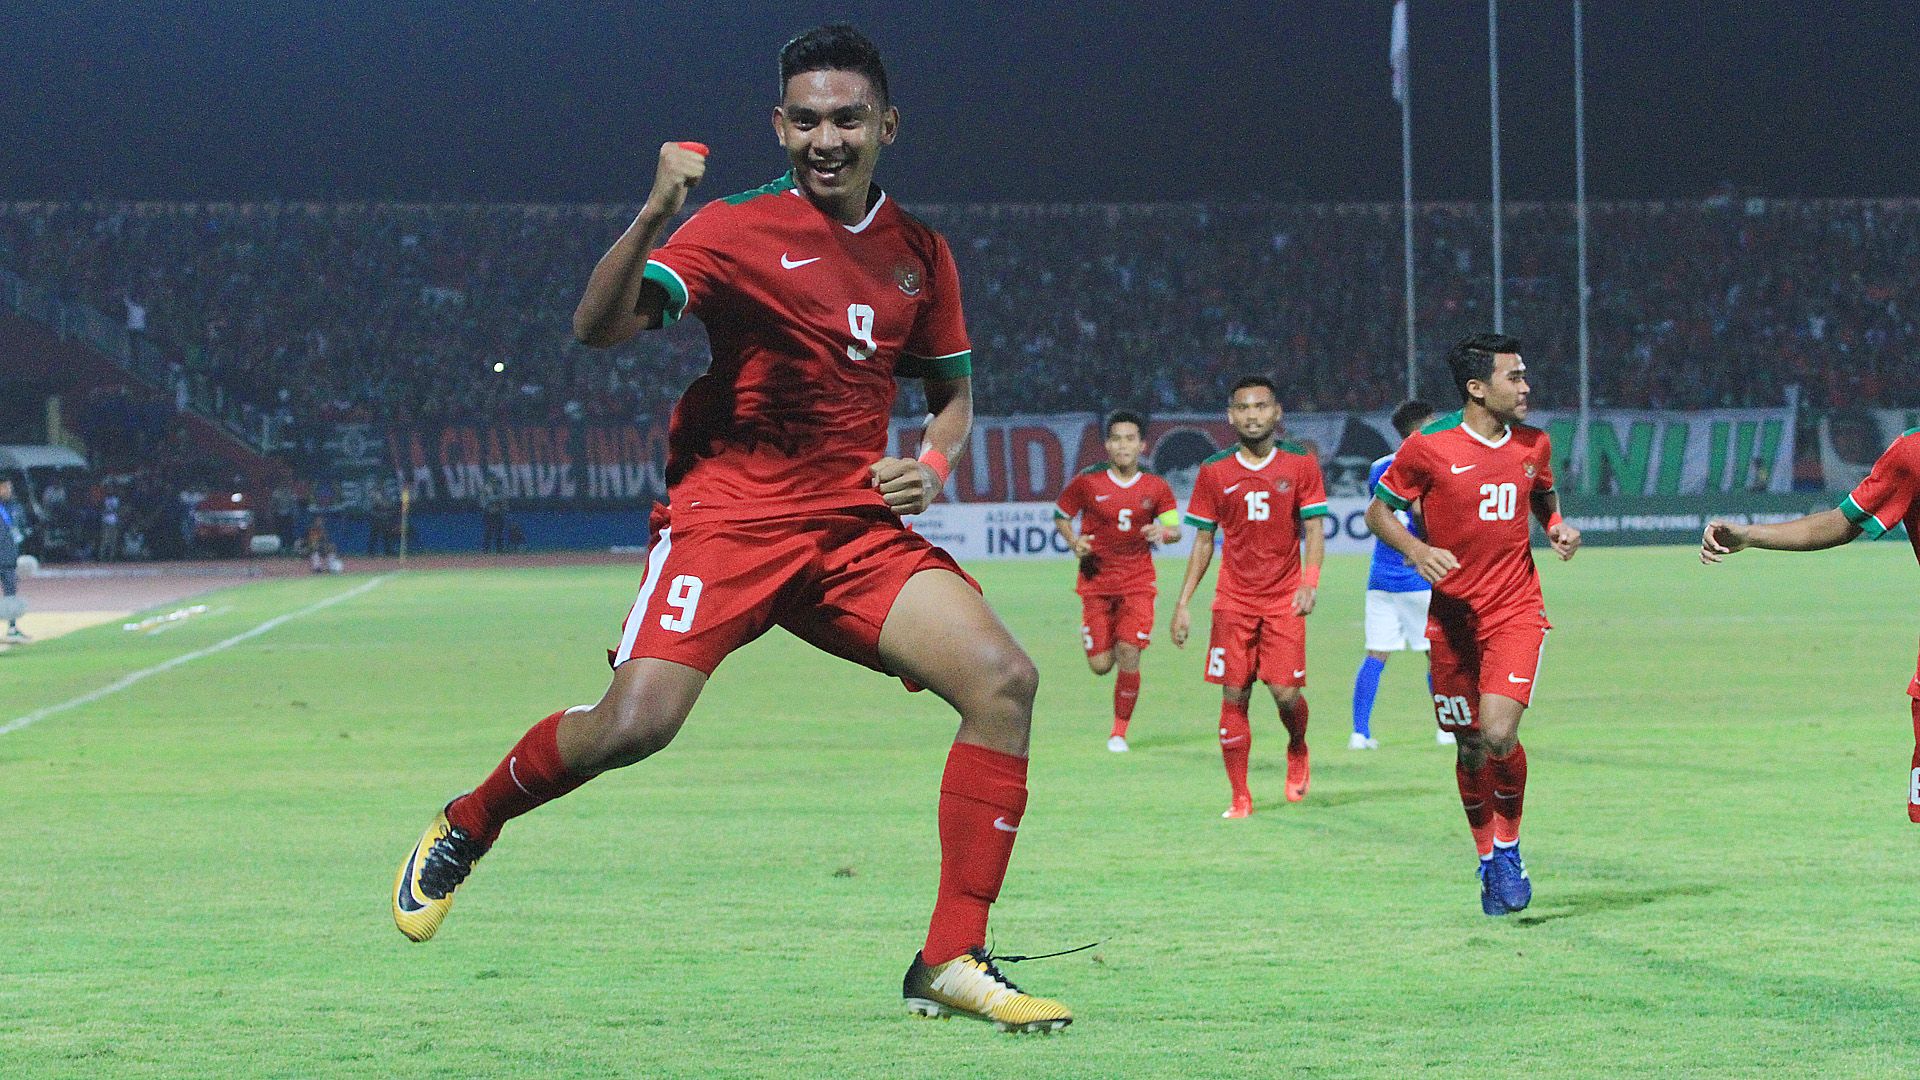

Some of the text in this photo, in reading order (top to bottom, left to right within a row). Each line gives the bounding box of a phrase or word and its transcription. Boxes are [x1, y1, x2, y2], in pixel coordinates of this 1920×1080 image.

[847, 303, 877, 361] 9
[1244, 490, 1270, 521] 15
[1479, 482, 1517, 521] 20
[1117, 508, 1133, 531] 5
[659, 574, 703, 633] 9
[1208, 647, 1226, 677] 15
[1434, 694, 1472, 726] 20
